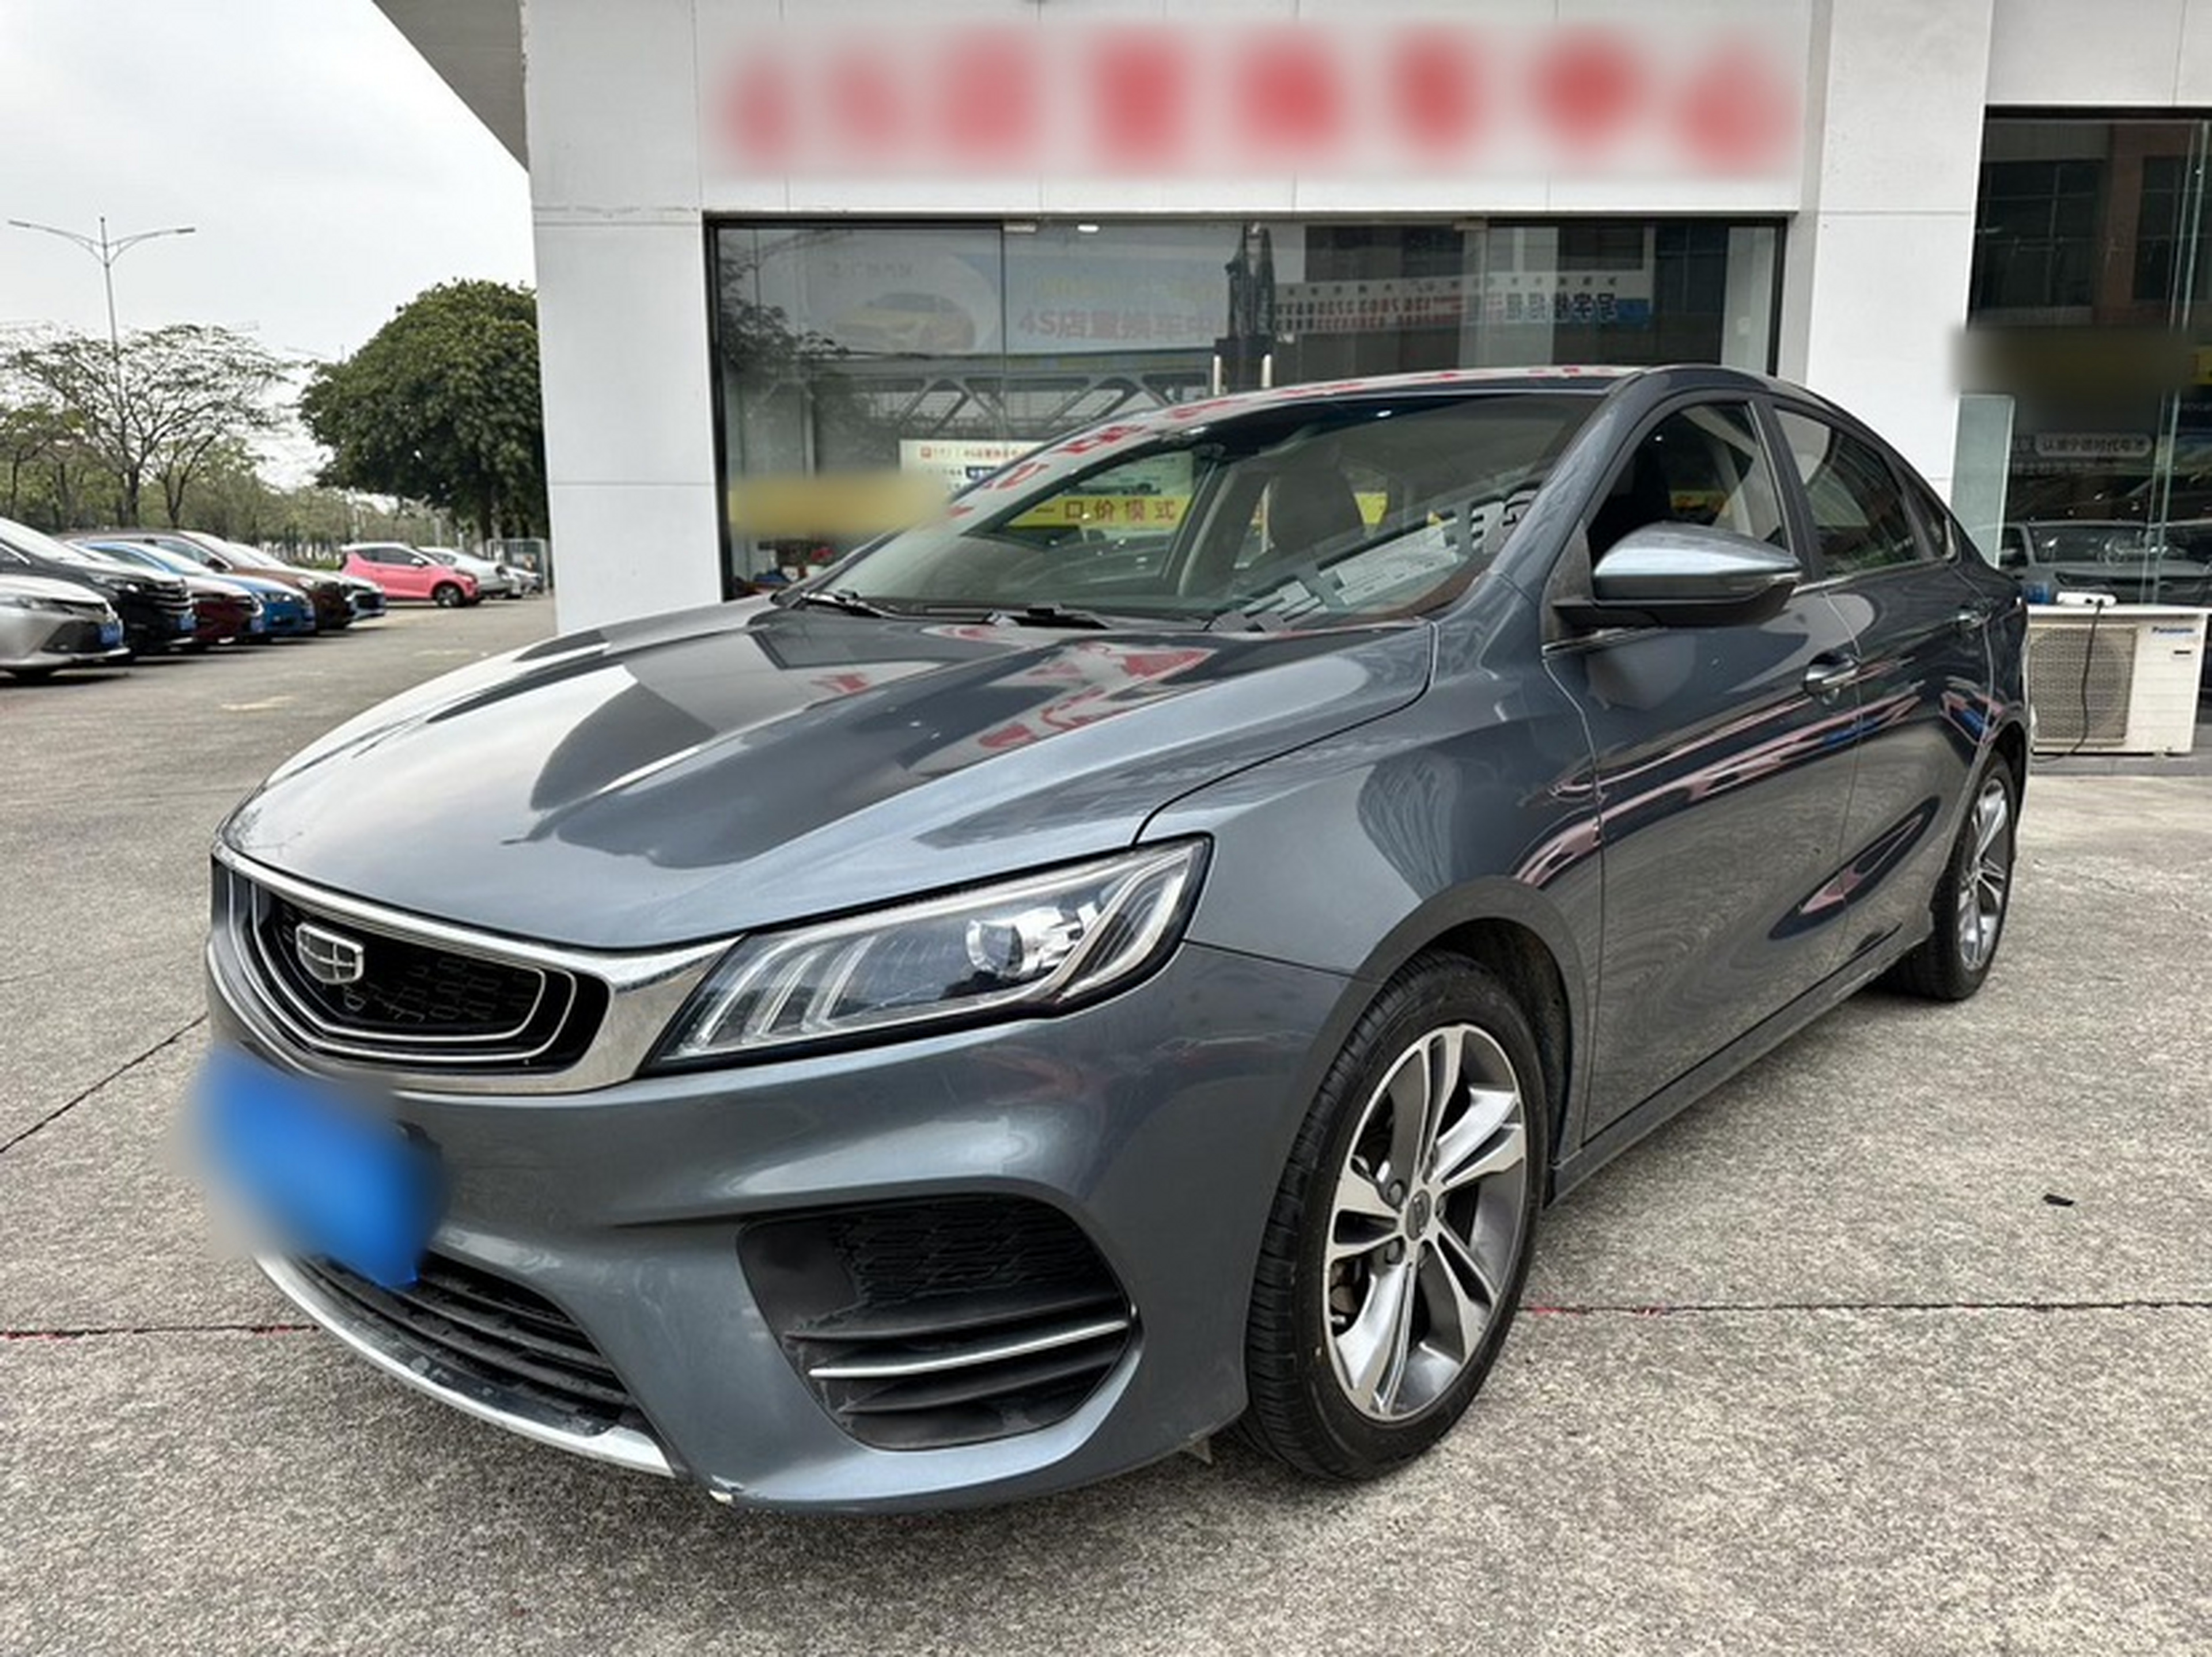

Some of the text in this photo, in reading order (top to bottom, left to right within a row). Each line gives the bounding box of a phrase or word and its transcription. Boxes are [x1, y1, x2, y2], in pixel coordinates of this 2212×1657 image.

[1034, 498, 1176, 521] 一口价模式
